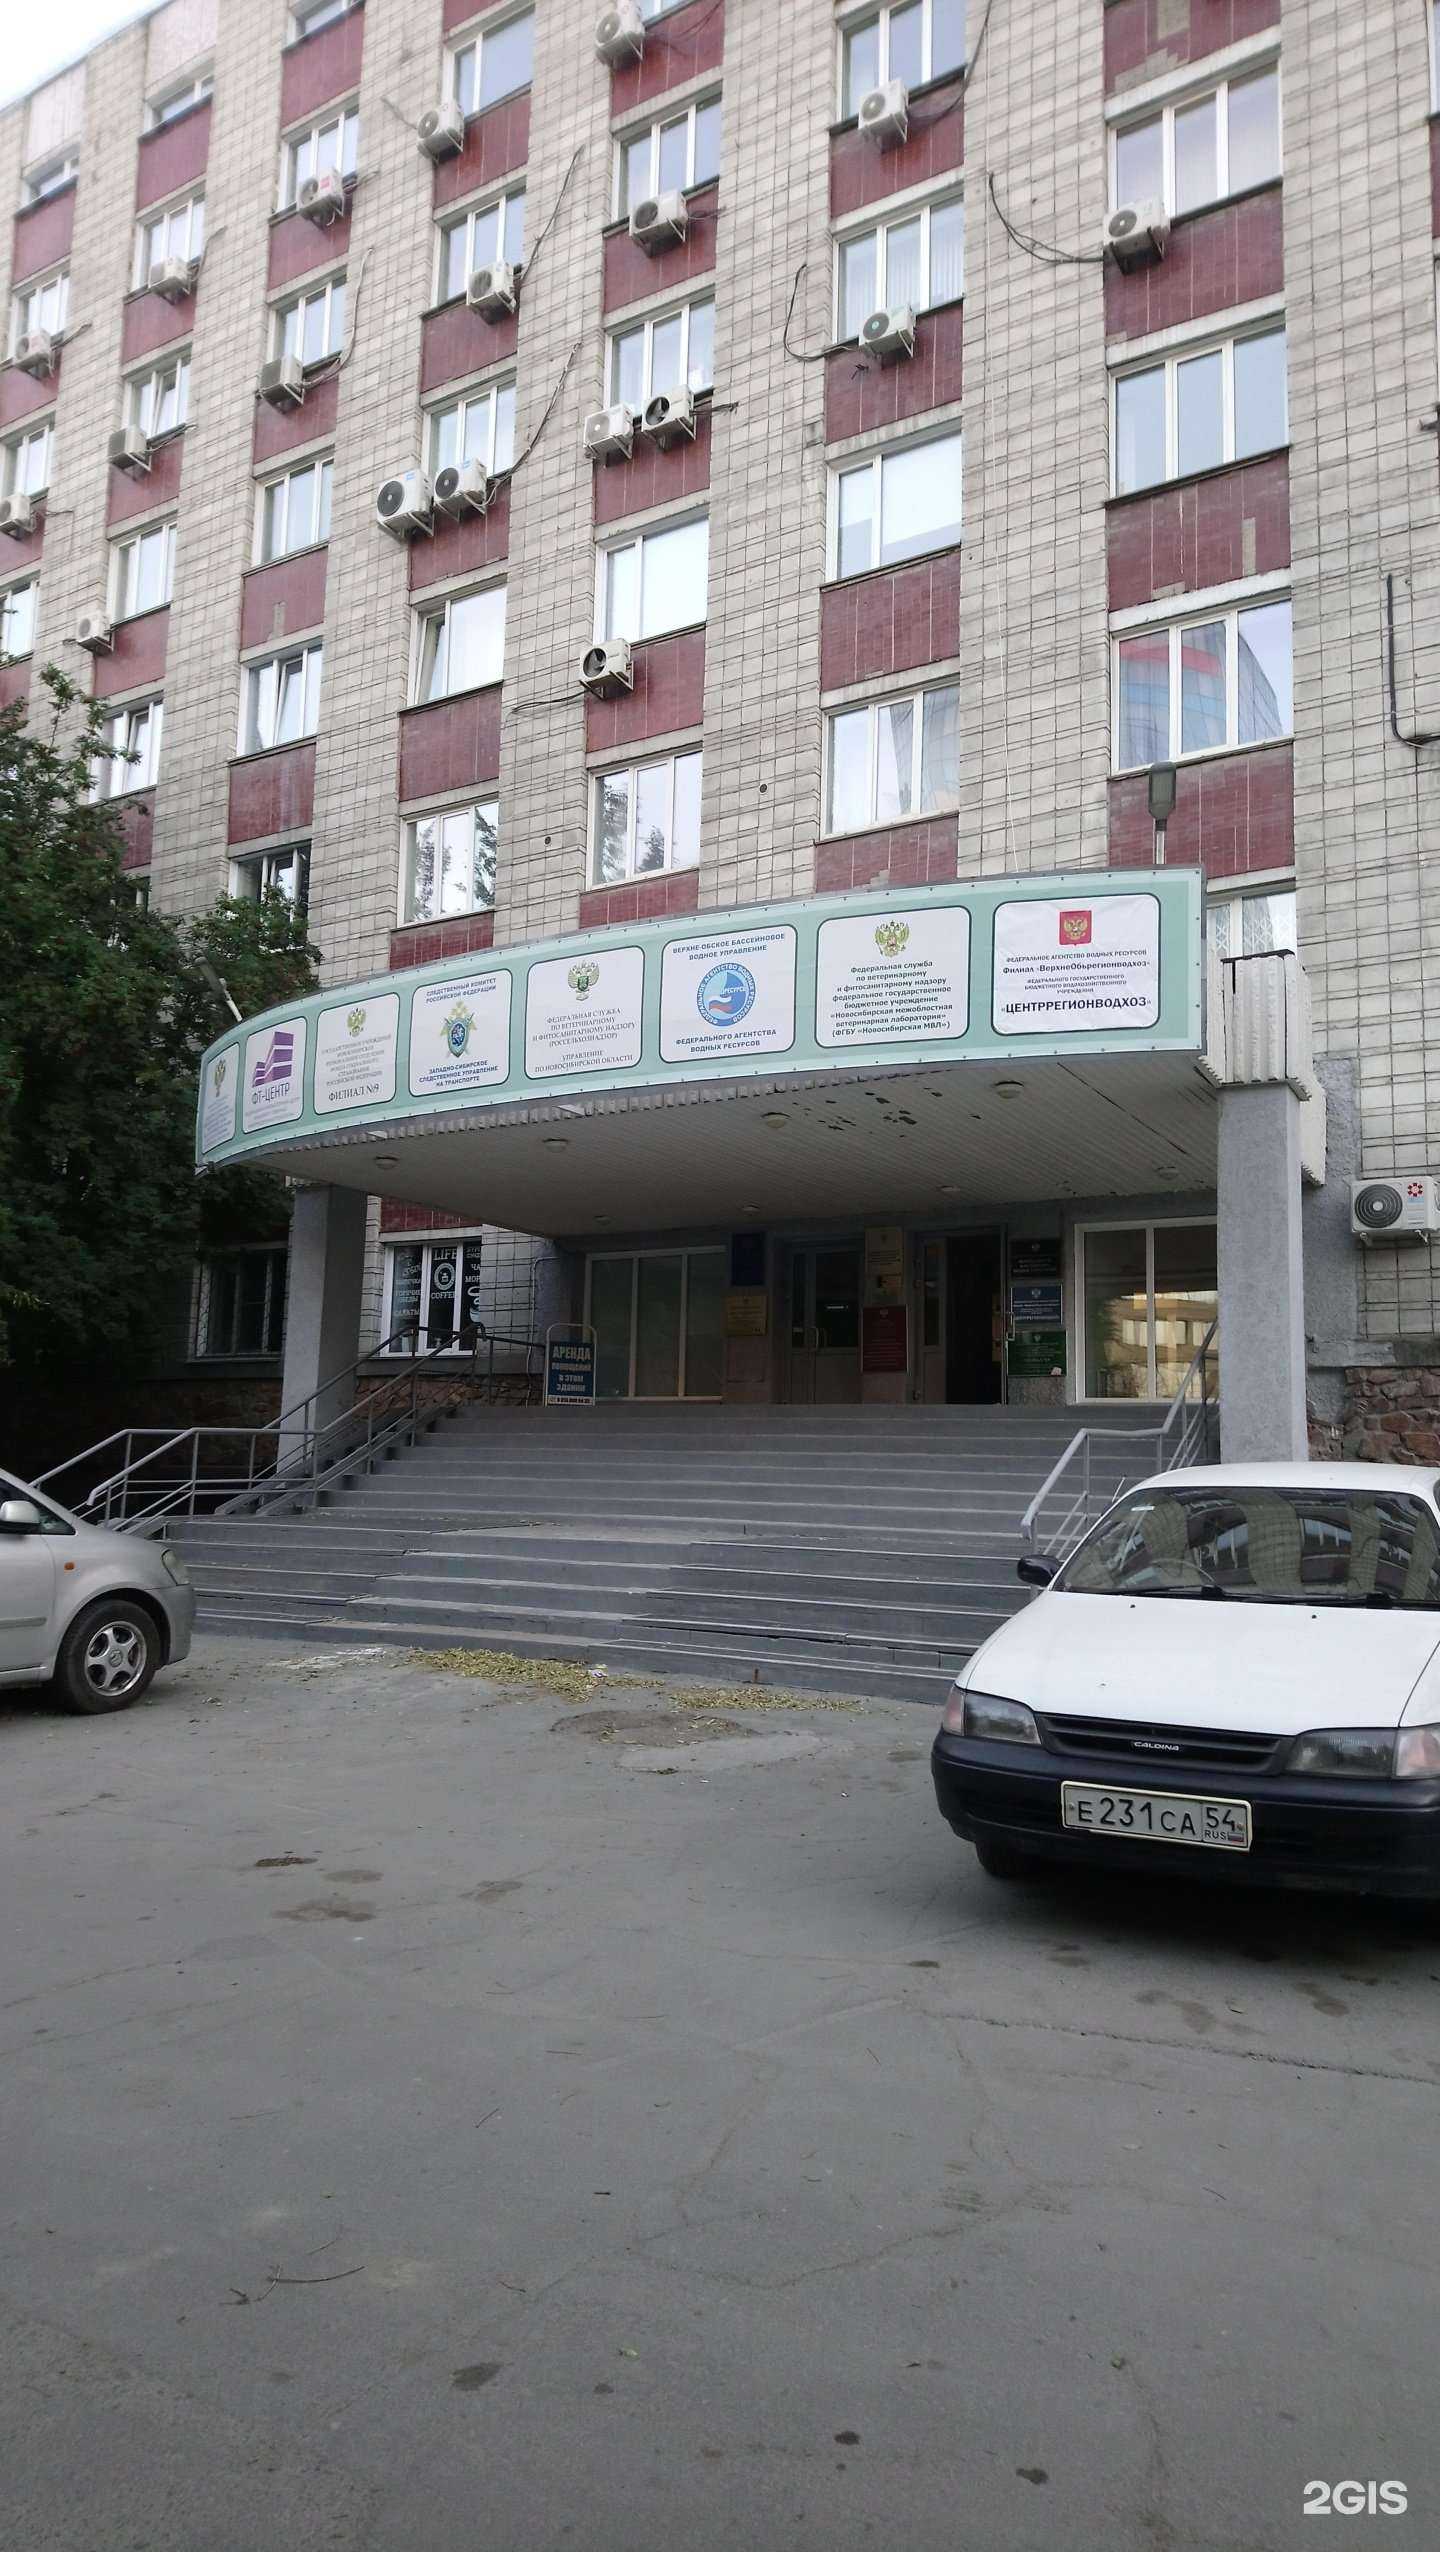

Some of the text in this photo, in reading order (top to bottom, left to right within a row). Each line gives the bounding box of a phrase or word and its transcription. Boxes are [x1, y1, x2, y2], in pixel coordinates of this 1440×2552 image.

[731, 933, 785, 946] БАССЕЙНОВОЕ
[689, 944, 767, 961] ВОДНОЕ УПРАВЛЕНИЕ
[1051, 952, 1085, 960] АГЕНТСТВО
[1114, 949, 1147, 957] РЕСУРСОВ
[851, 960, 933, 974] Федеральная служба
[1003, 966, 1034, 974] Филиал
[867, 971, 927, 981] ветеринарному
[843, 980, 913, 993] фитосанитарному
[915, 977, 947, 987] надзору
[832, 986, 952, 1003] федеральное государственное
[844, 996, 939, 1010] бюджетное учреждение
[895, 1003, 953, 1013] межобластная
[835, 1017, 890, 1028] ветеринарная
[676, 1029, 777, 1045] ФЕДЕРАЛЬНОГО АГЕНТСТВА
[832, 1028, 856, 1038] (ФГБУ
[690, 1040, 761, 1053] ВОДНЫХ РЕСУРСОВ
[328, 1085, 365, 1101] ФИЛИАЛ
[552, 1346, 592, 1361] АРЕНДА
[1134, 1741, 1180, 1752] CALDINA
[1206, 1806, 1235, 1832] 54
[1204, 1829, 1226, 1840] RUS
